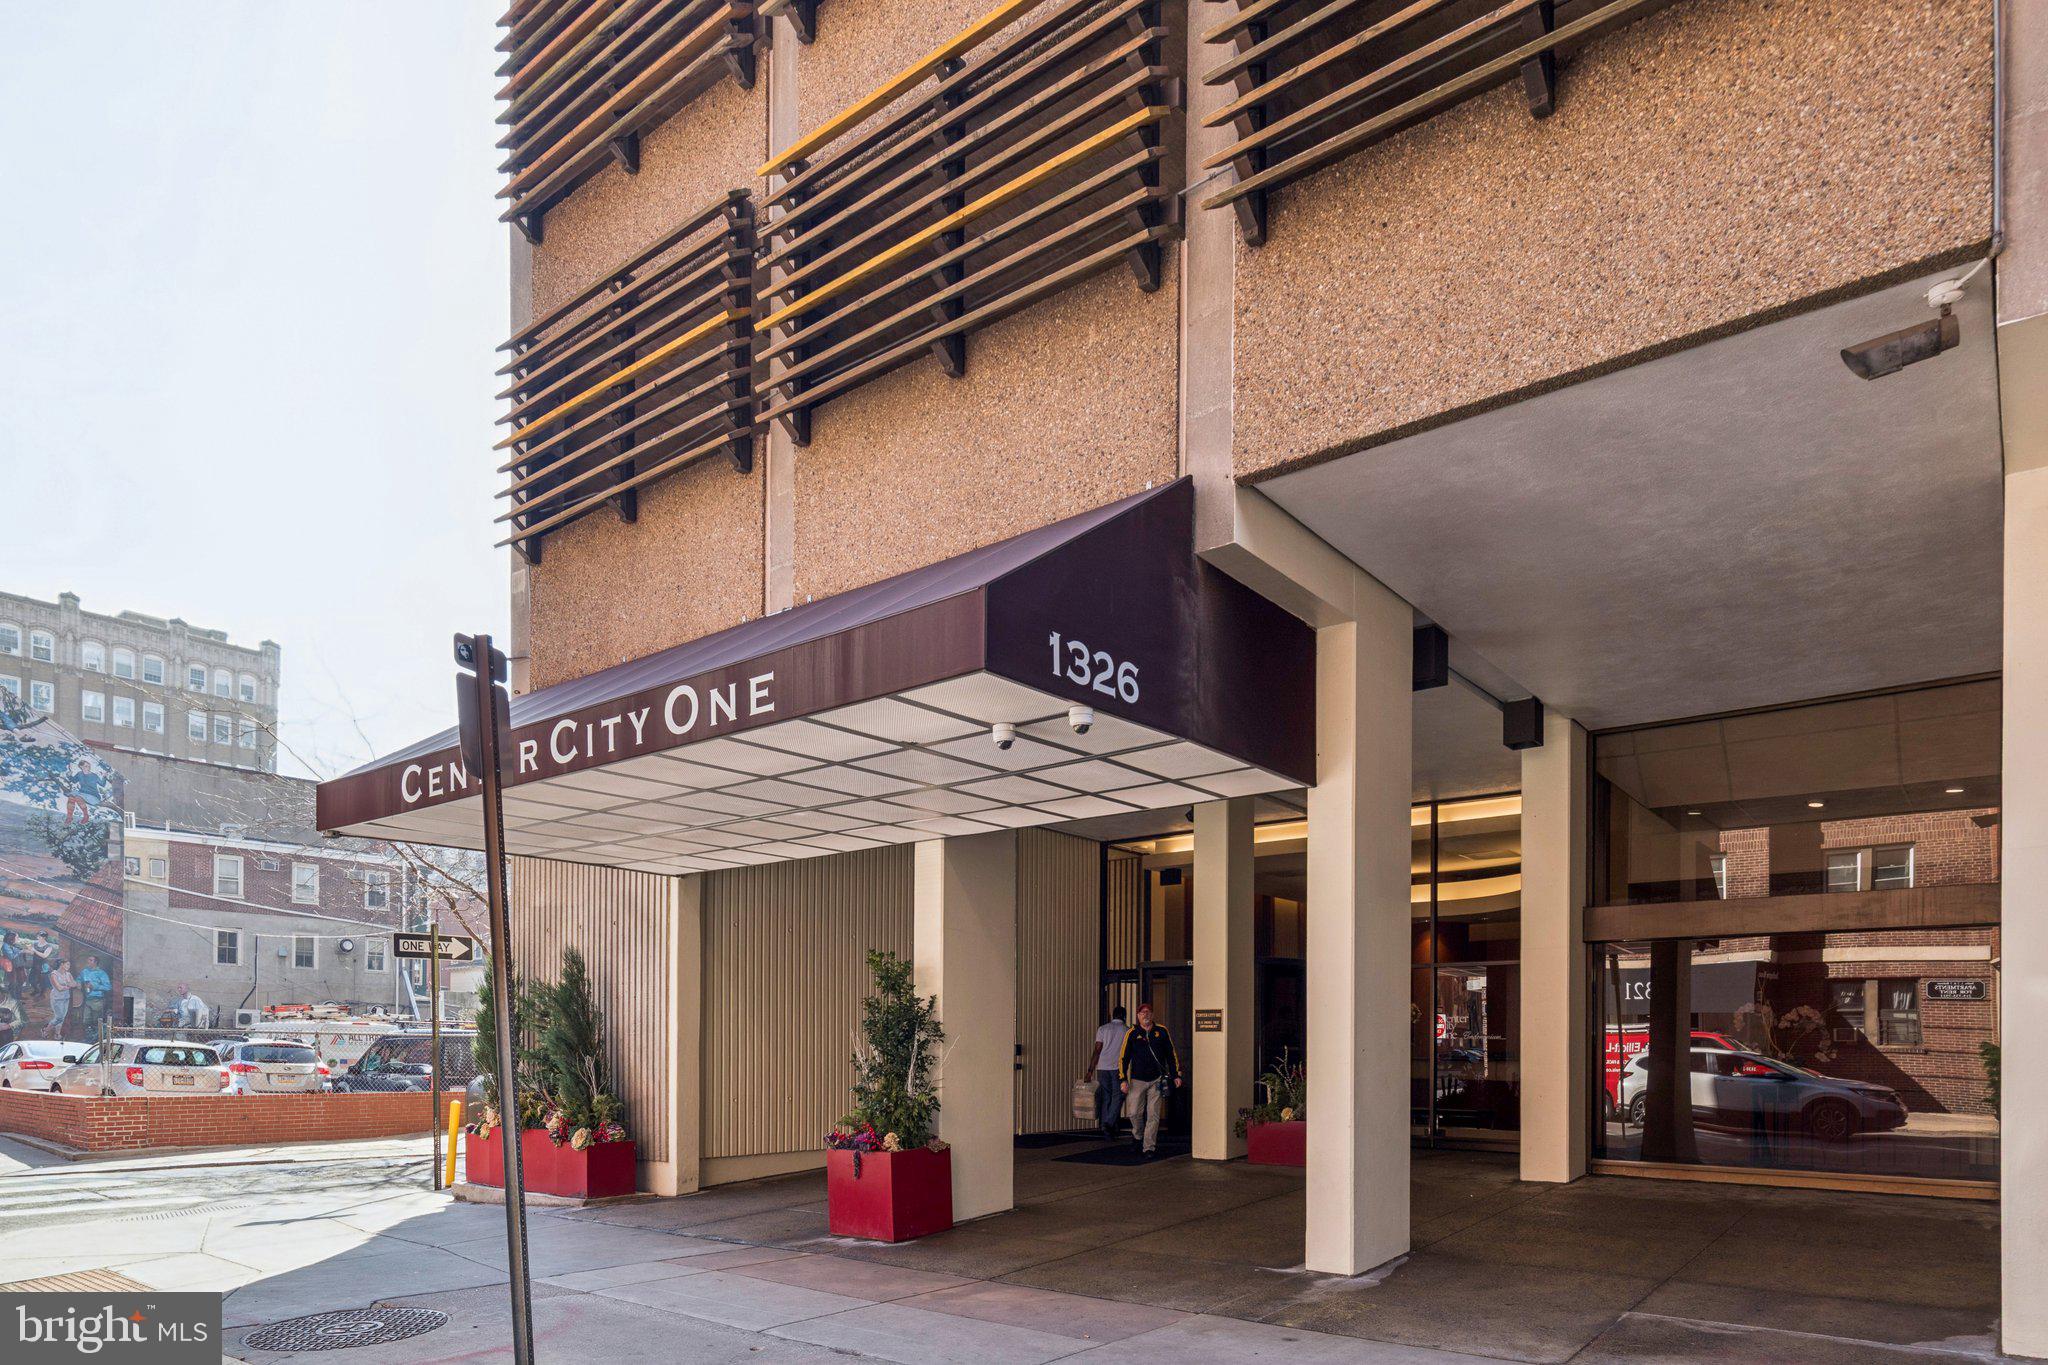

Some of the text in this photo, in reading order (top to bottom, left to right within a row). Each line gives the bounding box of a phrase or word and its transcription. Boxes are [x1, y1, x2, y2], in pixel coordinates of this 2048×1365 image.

[1050, 631, 1139, 704] 1326
[401, 671, 775, 803] CENR CITY ONE
[402, 940, 450, 952] ONE AY
